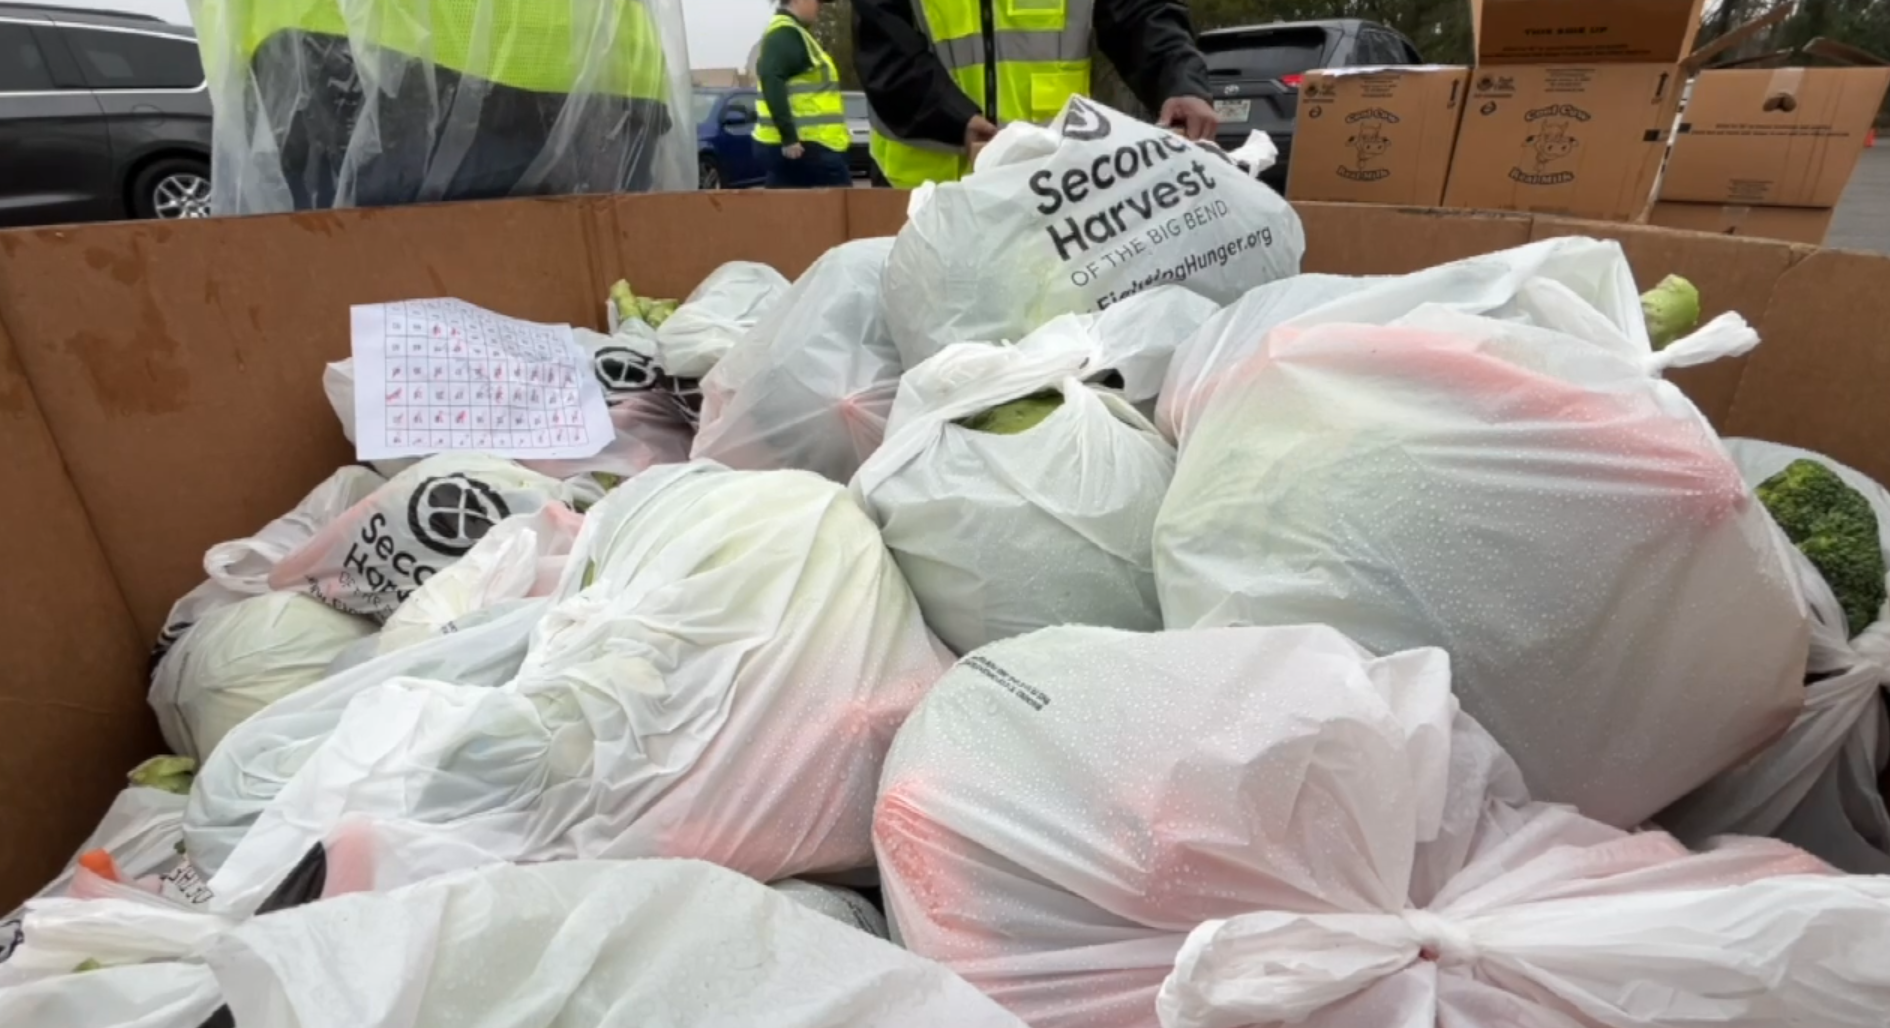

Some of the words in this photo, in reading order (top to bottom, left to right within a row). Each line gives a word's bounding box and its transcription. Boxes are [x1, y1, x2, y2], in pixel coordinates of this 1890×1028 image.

[1046, 159, 1216, 262] Harvest
[1070, 260, 1101, 287] OF
[1101, 237, 1147, 268] THE
[1147, 217, 1182, 245] BIG
[1183, 199, 1228, 231] BEND
